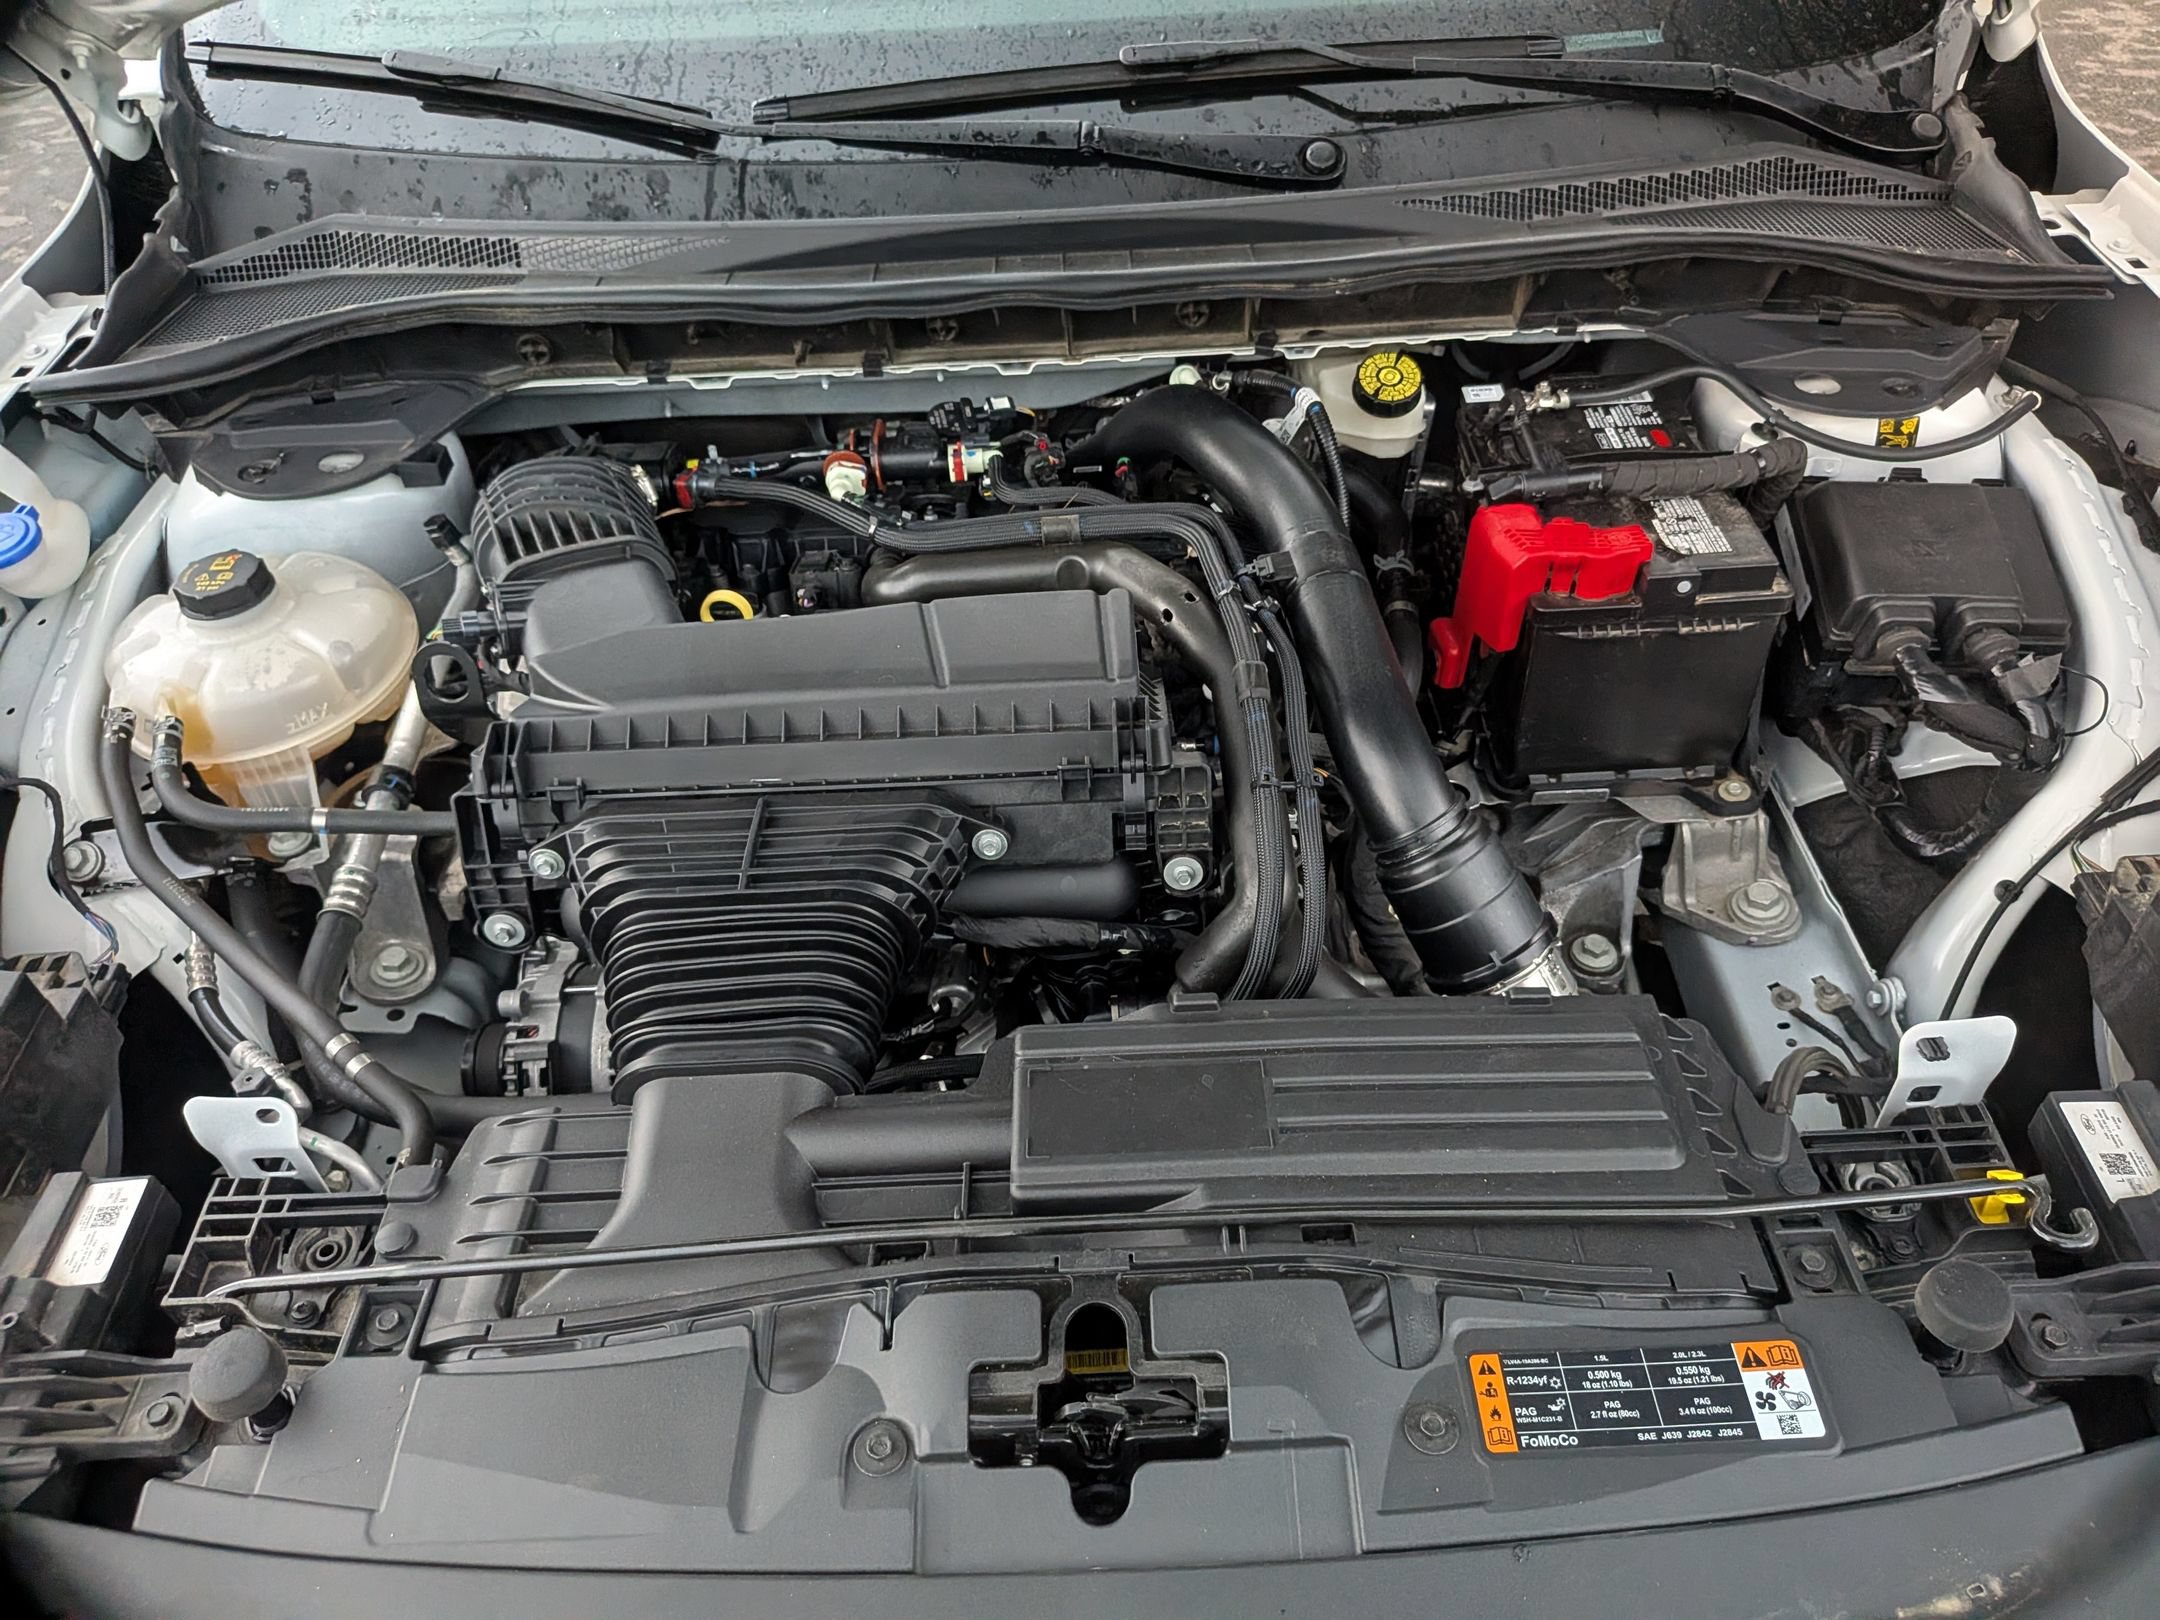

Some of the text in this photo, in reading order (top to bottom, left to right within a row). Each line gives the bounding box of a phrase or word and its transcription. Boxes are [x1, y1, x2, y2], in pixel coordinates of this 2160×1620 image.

[1587, 1369, 1622, 1380] 0.500 kg
[1675, 1365, 1711, 1375] 0.550 kg
[1506, 1376, 1548, 1387] R-1234yf
[1582, 1378, 1633, 1389] 18 oz (1.10 lbs)
[1667, 1374, 1725, 1385] 19.5 oz (1.21 lbs)
[1603, 1400, 1621, 1409] PAG
[1693, 1396, 1711, 1406] PAG
[1514, 1407, 1537, 1417] PAG
[1590, 1408, 1640, 1420] 2.7 fl oz (80cc)
[1678, 1404, 1733, 1416] 3.4 fl oz (100cc)
[1637, 1427, 1743, 1441] SAE J639 J2842 J2845
[1520, 1433, 1579, 1448] FoMoCo
